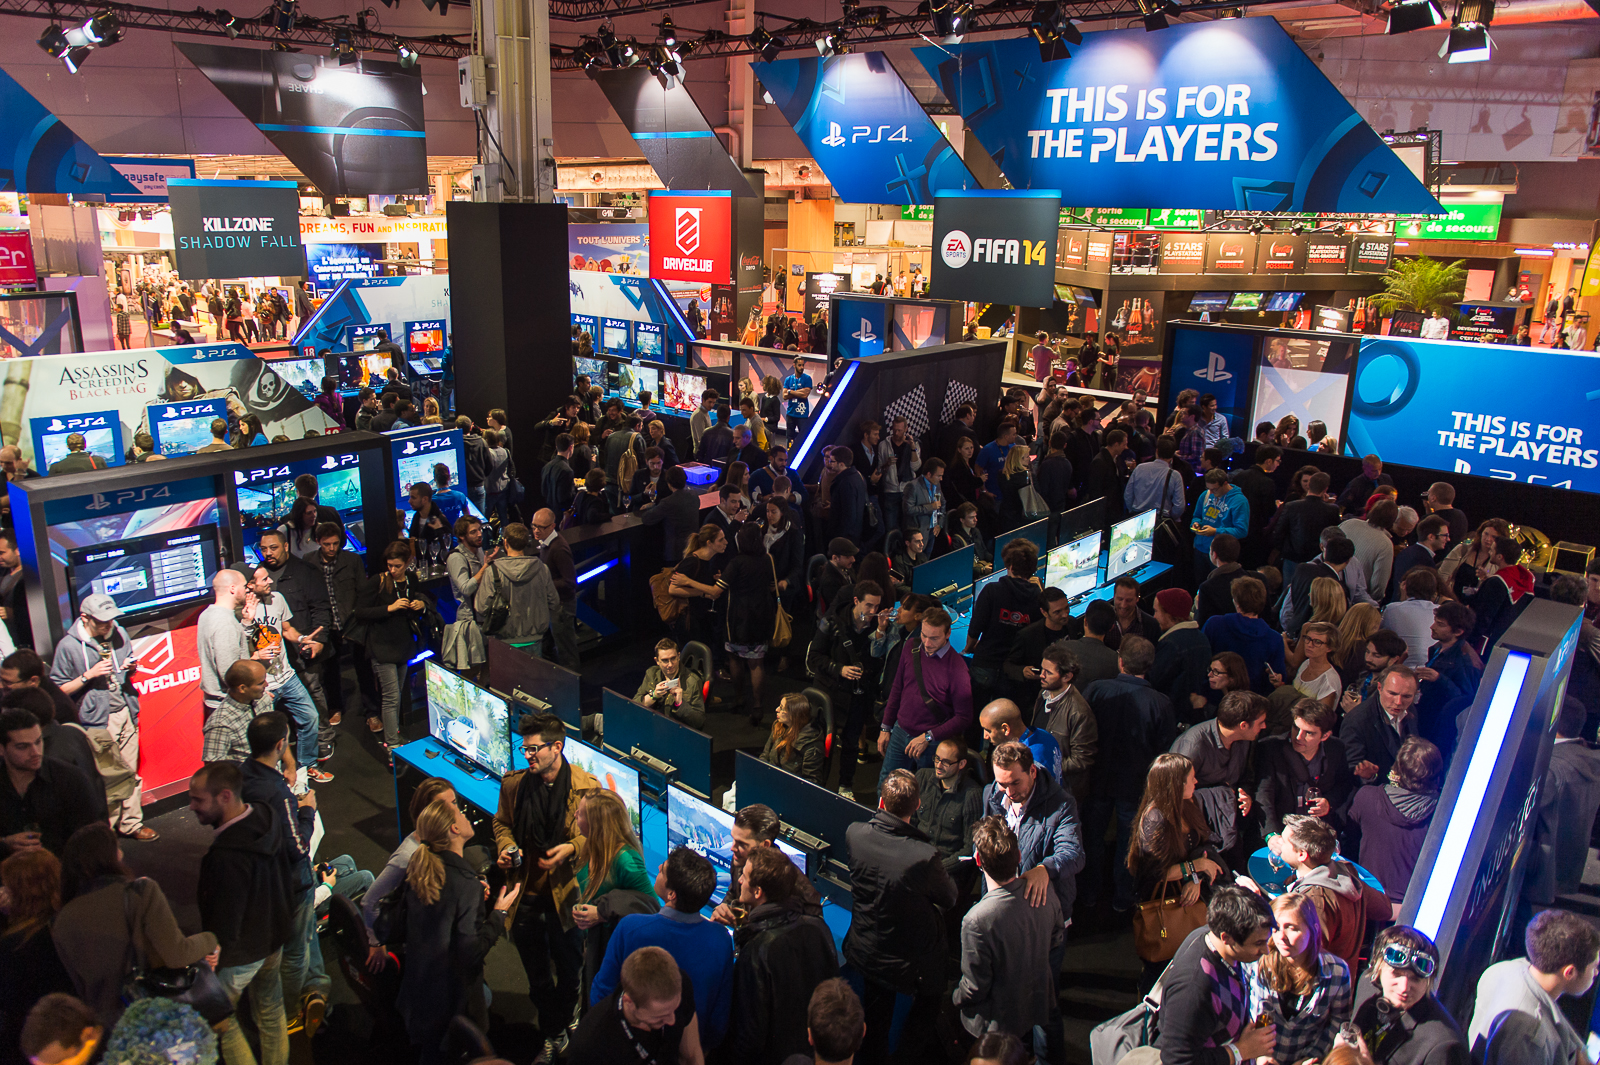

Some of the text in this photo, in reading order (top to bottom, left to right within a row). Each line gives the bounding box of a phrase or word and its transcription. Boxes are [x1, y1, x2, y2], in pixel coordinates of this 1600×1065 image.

[288, 83, 324, 94] SHARE
[1046, 84, 1251, 123] THIS IS FOR
[851, 125, 909, 143] PS4
[1027, 122, 1279, 163] THE PLAYERS
[918, 211, 928, 219] de
[1096, 216, 1144, 226] de secours
[203, 217, 273, 232] KILLZONE
[1173, 217, 1185, 226] de
[1426, 221, 1494, 233] de secours
[300, 223, 350, 235] DREAMS,
[352, 223, 375, 233] FUN
[180, 236, 297, 249] SHADOW FALL
[577, 236, 641, 244] TOUT L'UNIVERS
[947, 239, 966, 252] EA
[972, 238, 1020, 265] FIFA
[1023, 239, 1047, 266] 14
[1164, 242, 1203, 251] 4 STARS
[1366, 243, 1389, 251] STARS
[945, 251, 967, 259] SPORTS
[663, 257, 713, 273] DRIVECLUB
[422, 322, 441, 330] PS4
[580, 316, 594, 324] PS4
[611, 320, 626, 328] PS4
[646, 324, 660, 332] PS4
[208, 348, 238, 358] PS4
[304, 348, 315, 356] 18
[676, 344, 684, 354] 18
[58, 359, 149, 386] ASSASSIN'S
[78, 375, 137, 390] CREED IV
[69, 382, 147, 401] BLACK FLAG
[180, 404, 215, 416] PS4
[67, 416, 107, 429] PS4
[1451, 411, 1583, 445] THIS IS FOR
[419, 437, 452, 451] PS4
[1437, 430, 1599, 469] THE PLAYERS
[250, 465, 291, 481] PS4
[117, 485, 172, 505] PS4
[132, 666, 201, 695] VECLUB
